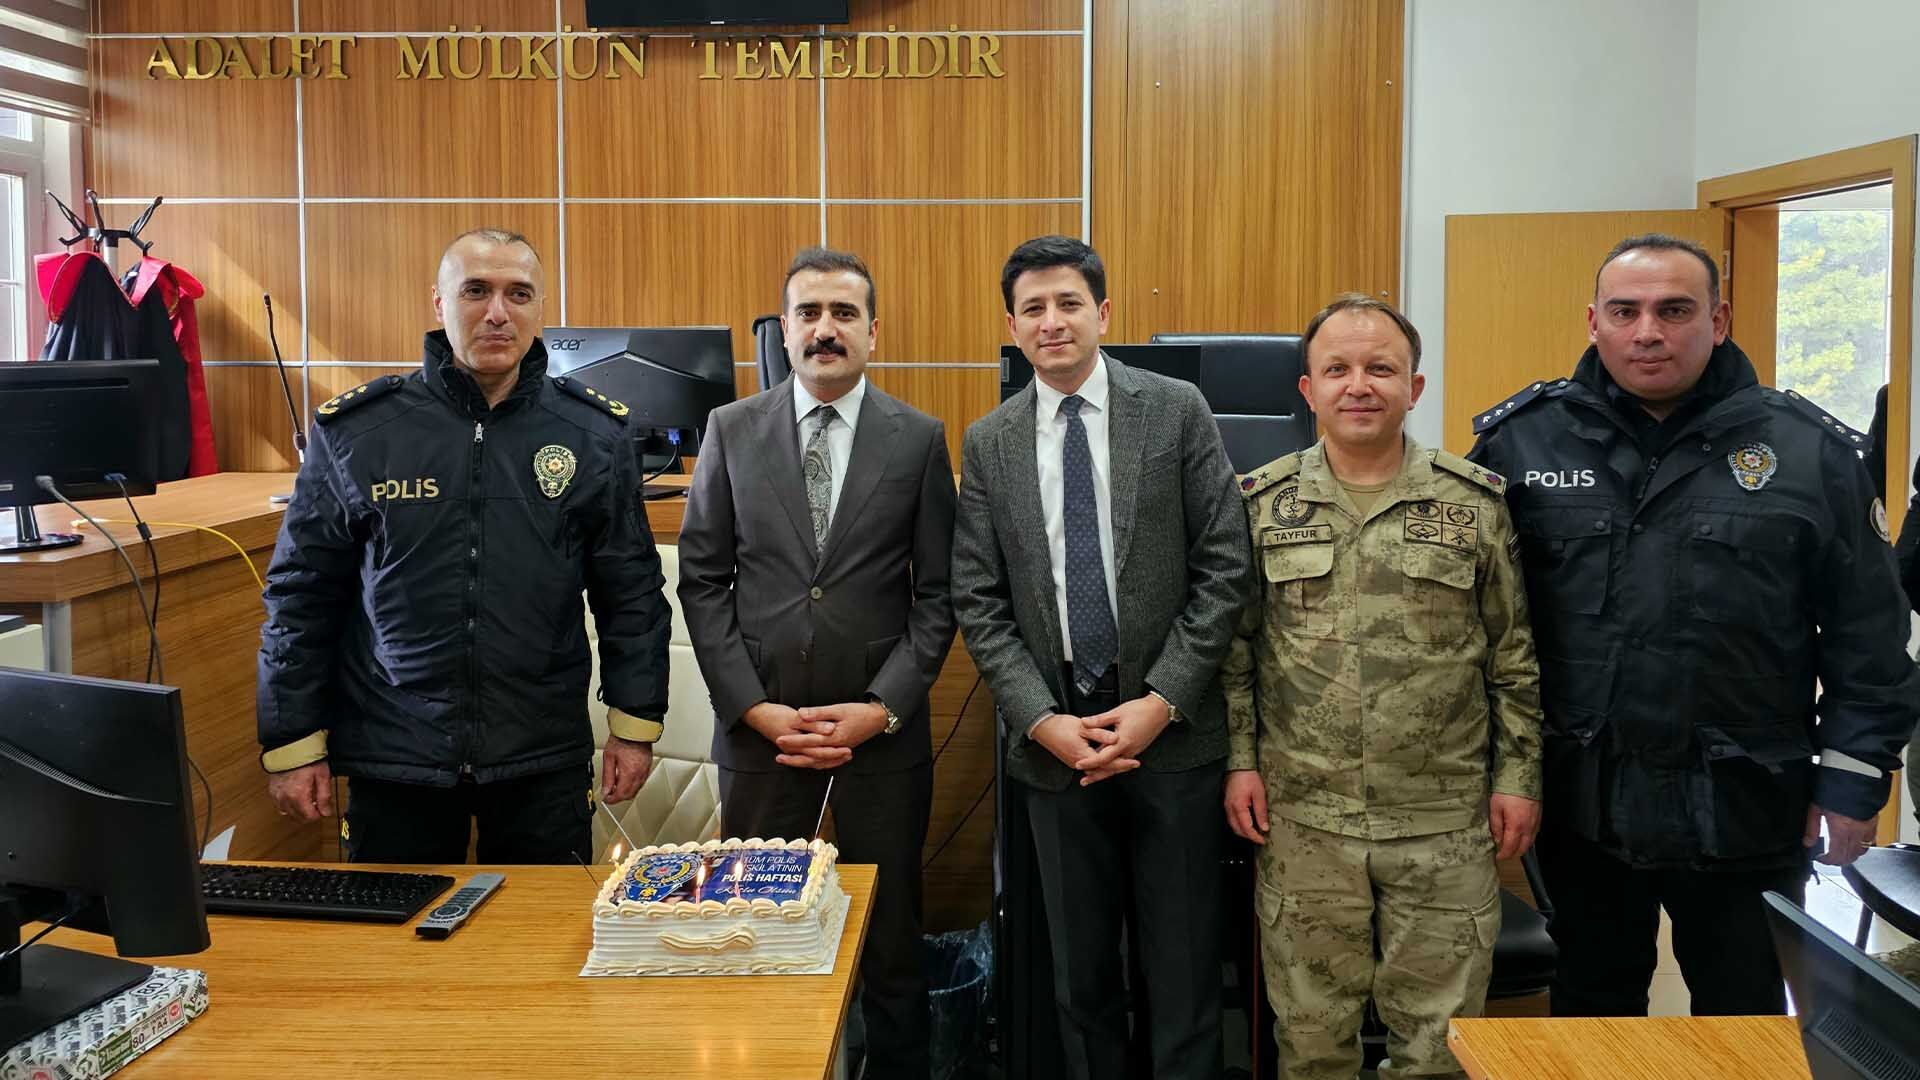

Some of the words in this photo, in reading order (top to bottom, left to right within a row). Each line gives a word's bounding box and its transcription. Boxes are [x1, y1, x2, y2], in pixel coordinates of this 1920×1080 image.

[147, 35, 357, 81] ADALET
[396, 25, 649, 80] MÜLKÜN
[690, 24, 1006, 80] TEMELİDİR
[551, 338, 586, 351] acer
[1273, 530, 1318, 542] TAYFUR
[755, 873, 803, 883] HAFTASI
[136, 982, 164, 995] 80
